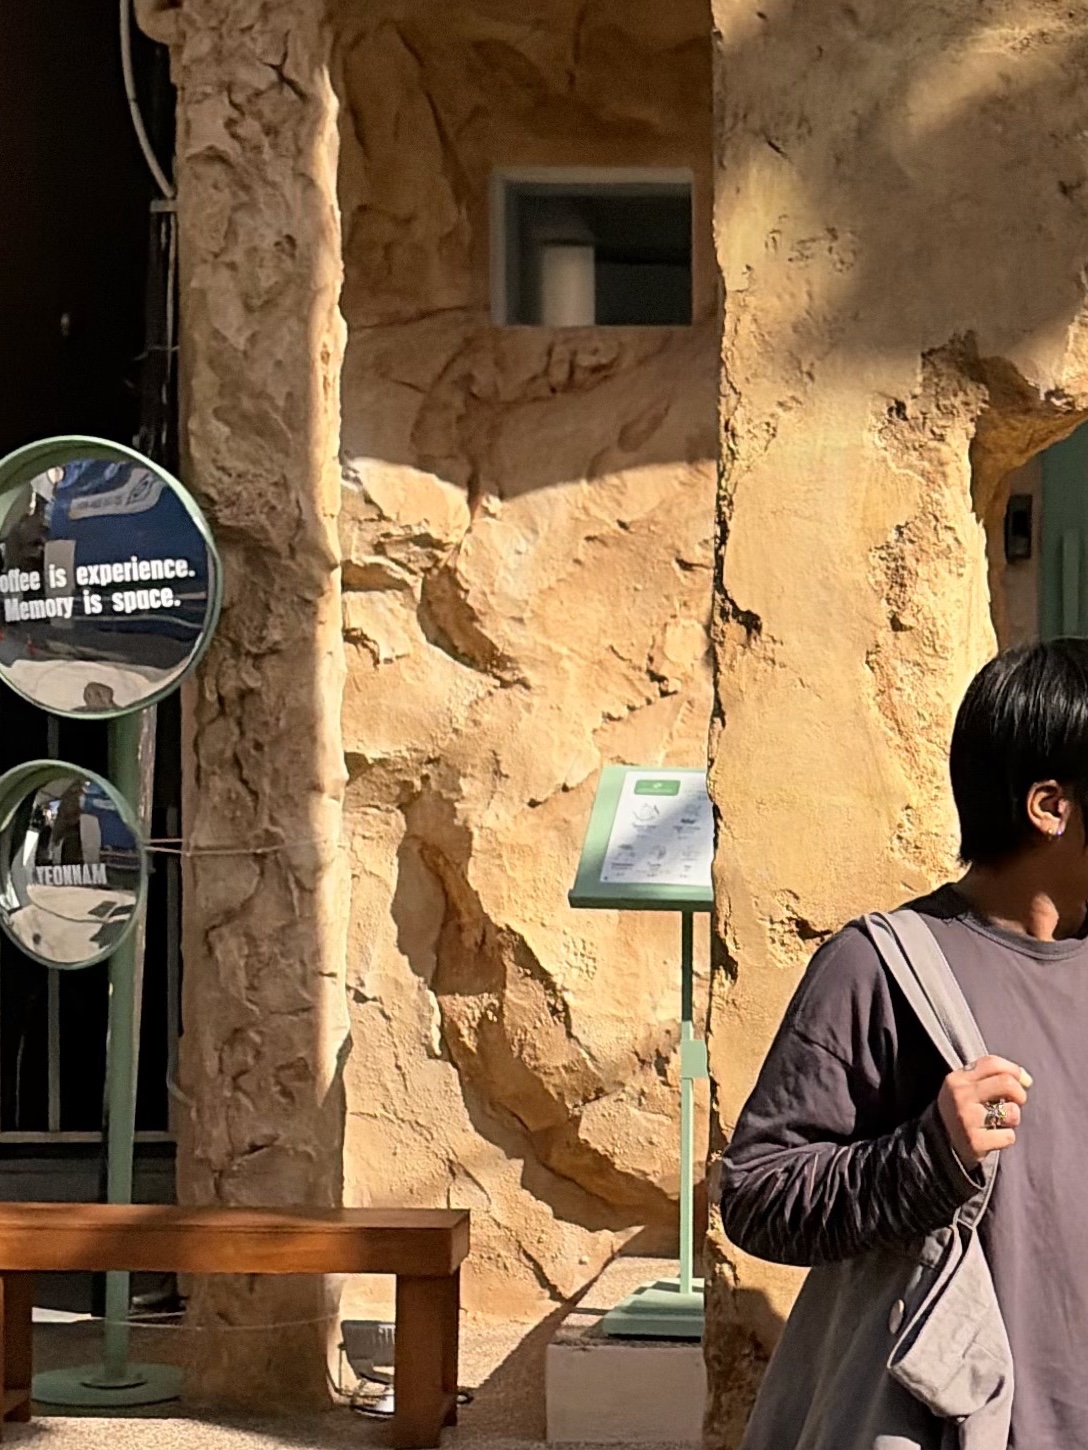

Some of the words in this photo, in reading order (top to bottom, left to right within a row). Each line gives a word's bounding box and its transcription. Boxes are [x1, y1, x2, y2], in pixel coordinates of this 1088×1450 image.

[49, 564, 67, 589] is
[76, 556, 196, 586] experience.
[4, 596, 74, 622] Memory
[83, 589, 103, 614] is
[112, 587, 181, 614] space.
[35, 863, 107, 885] YEONNAM
